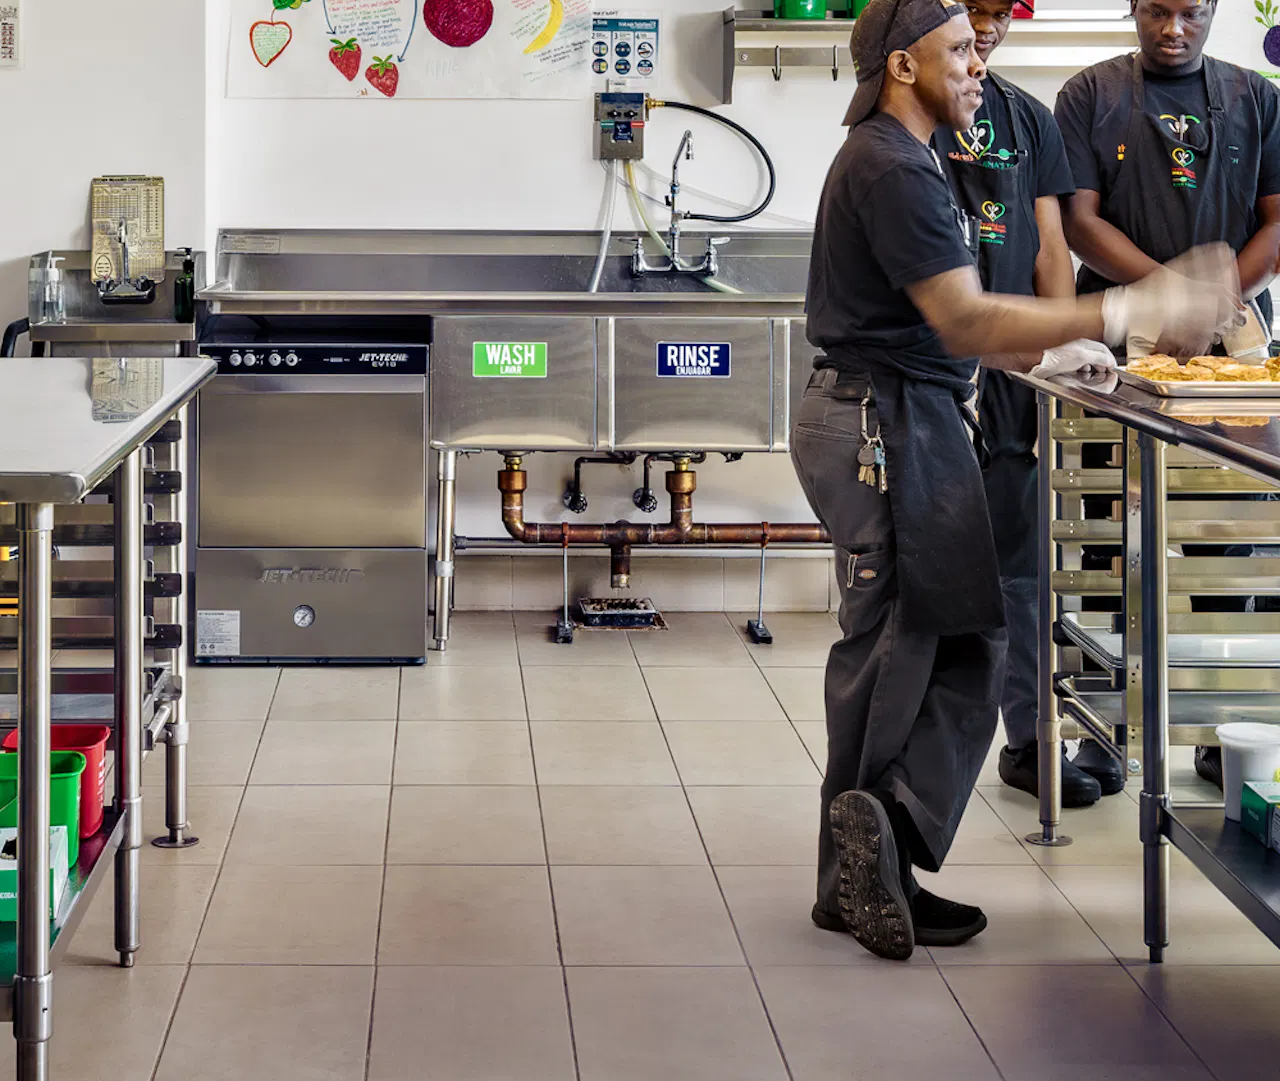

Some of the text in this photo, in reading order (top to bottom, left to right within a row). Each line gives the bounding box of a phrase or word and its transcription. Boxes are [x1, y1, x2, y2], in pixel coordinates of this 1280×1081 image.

[486, 344, 535, 365] WASH
[667, 345, 720, 367] RINSE
[500, 366, 522, 375] LAVAR
[676, 366, 711, 375] ENJUAGAR
